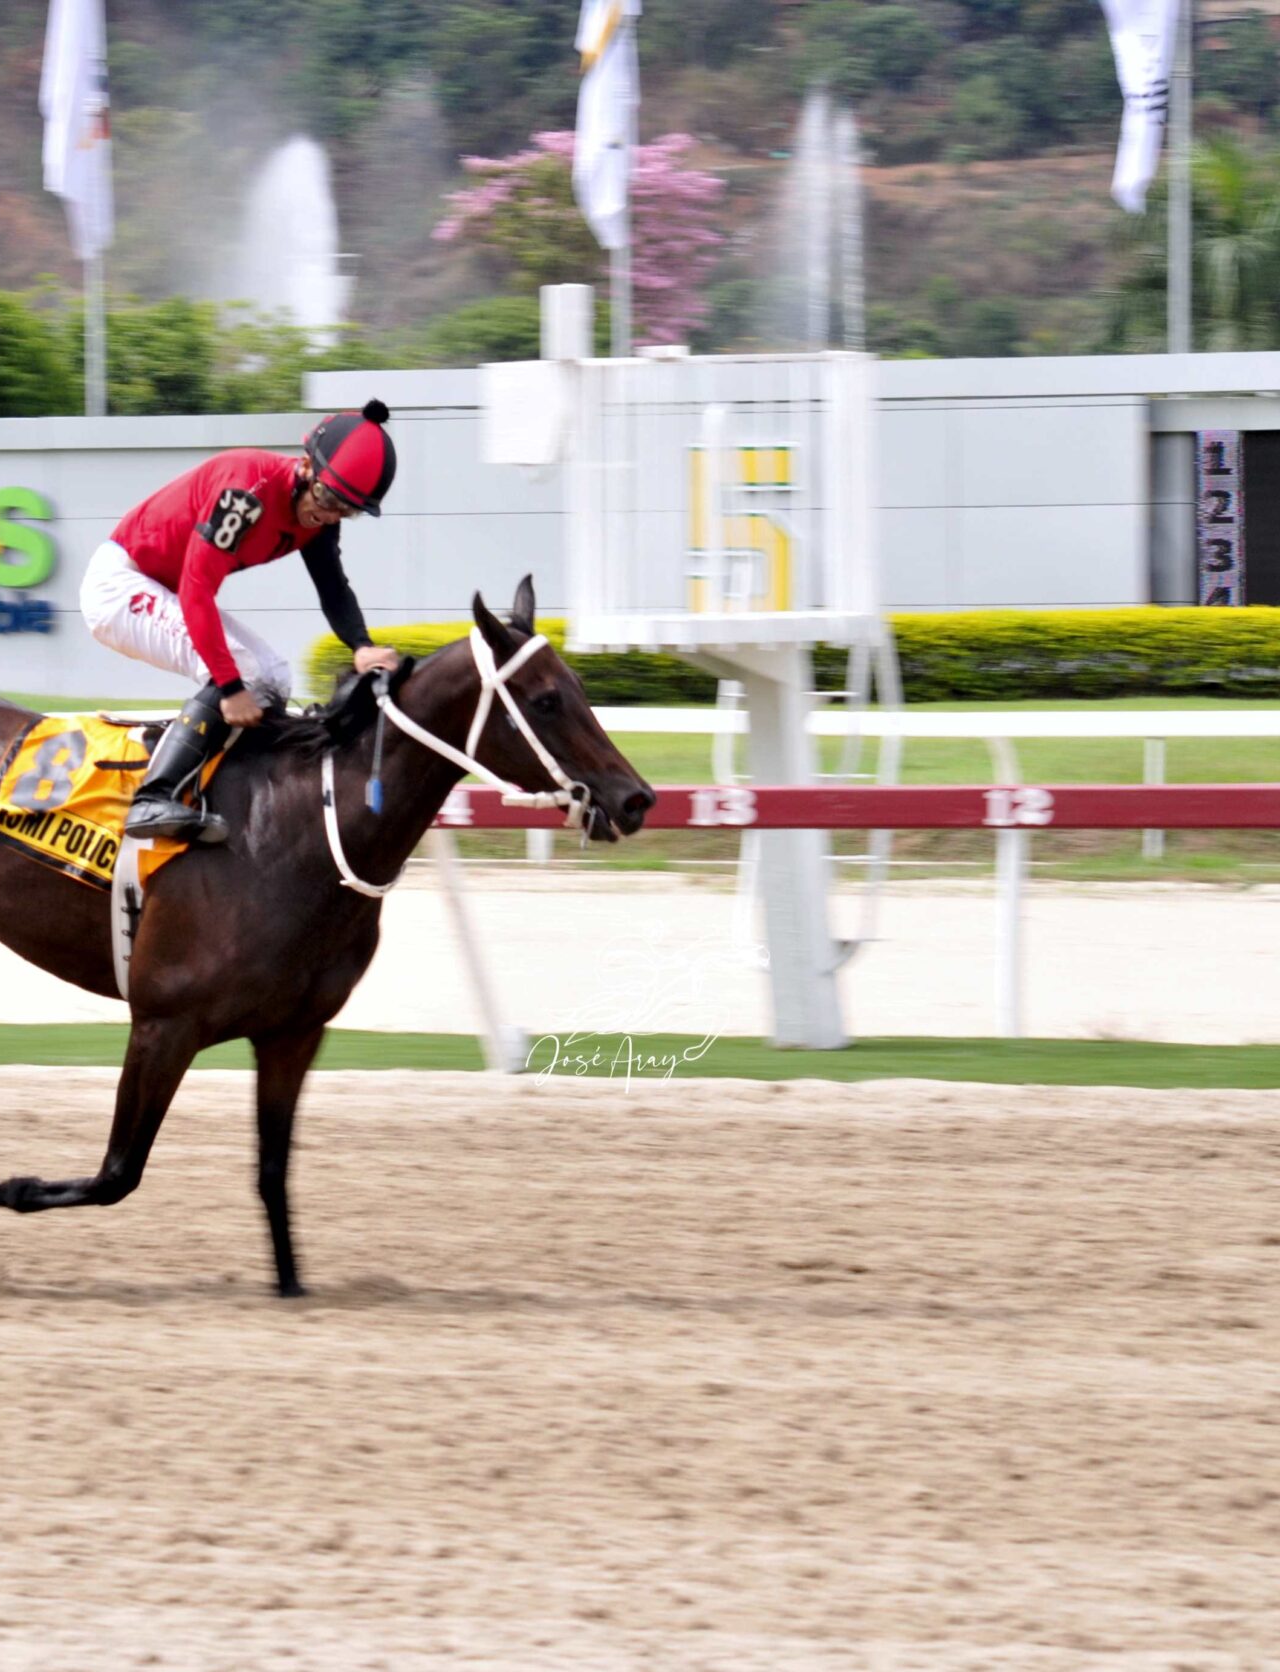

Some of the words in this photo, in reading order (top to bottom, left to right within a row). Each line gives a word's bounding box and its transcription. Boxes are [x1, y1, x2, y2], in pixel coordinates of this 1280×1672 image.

[1204, 441, 1233, 476] 1
[1205, 489, 1235, 524] 2
[214, 512, 242, 549] 8
[1206, 538, 1234, 573] 3
[9, 729, 88, 811] 8
[687, 788, 758, 826] 13
[981, 788, 1055, 826] 12
[50, 817, 117, 873] POLIC
